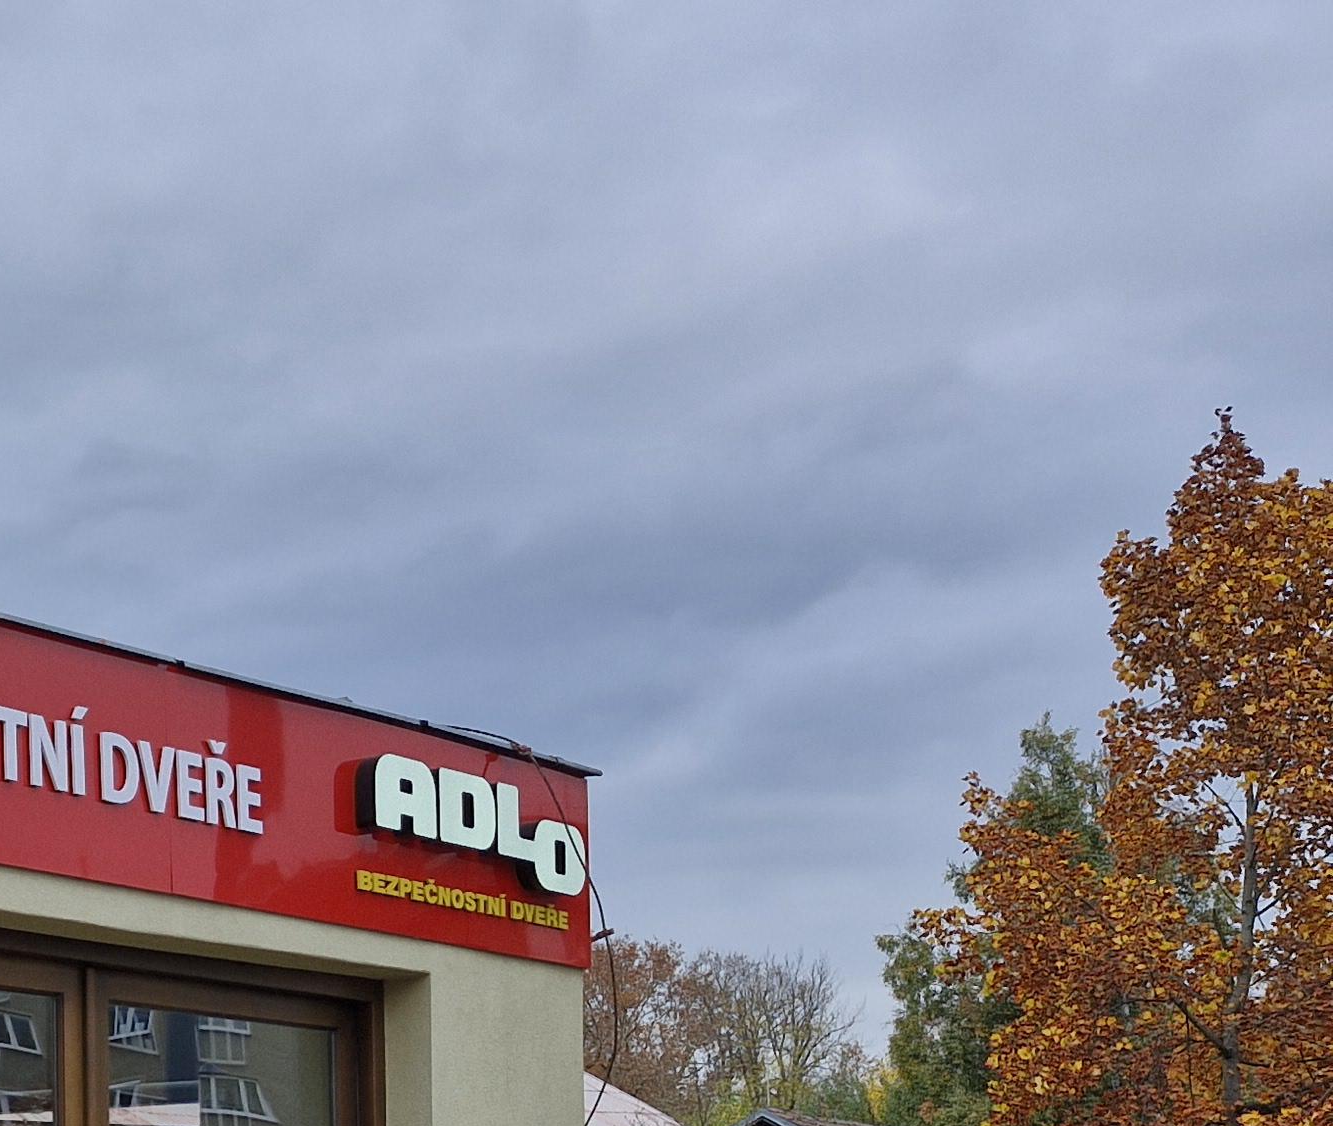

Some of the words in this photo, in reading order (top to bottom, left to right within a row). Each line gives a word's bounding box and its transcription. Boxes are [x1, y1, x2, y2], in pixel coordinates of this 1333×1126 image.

[100, 731, 264, 836] DVEŘE
[374, 753, 587, 897] ADLO
[356, 869, 507, 918] BEZPEČNOSTNÍ
[510, 900, 569, 931] DVEŘE
